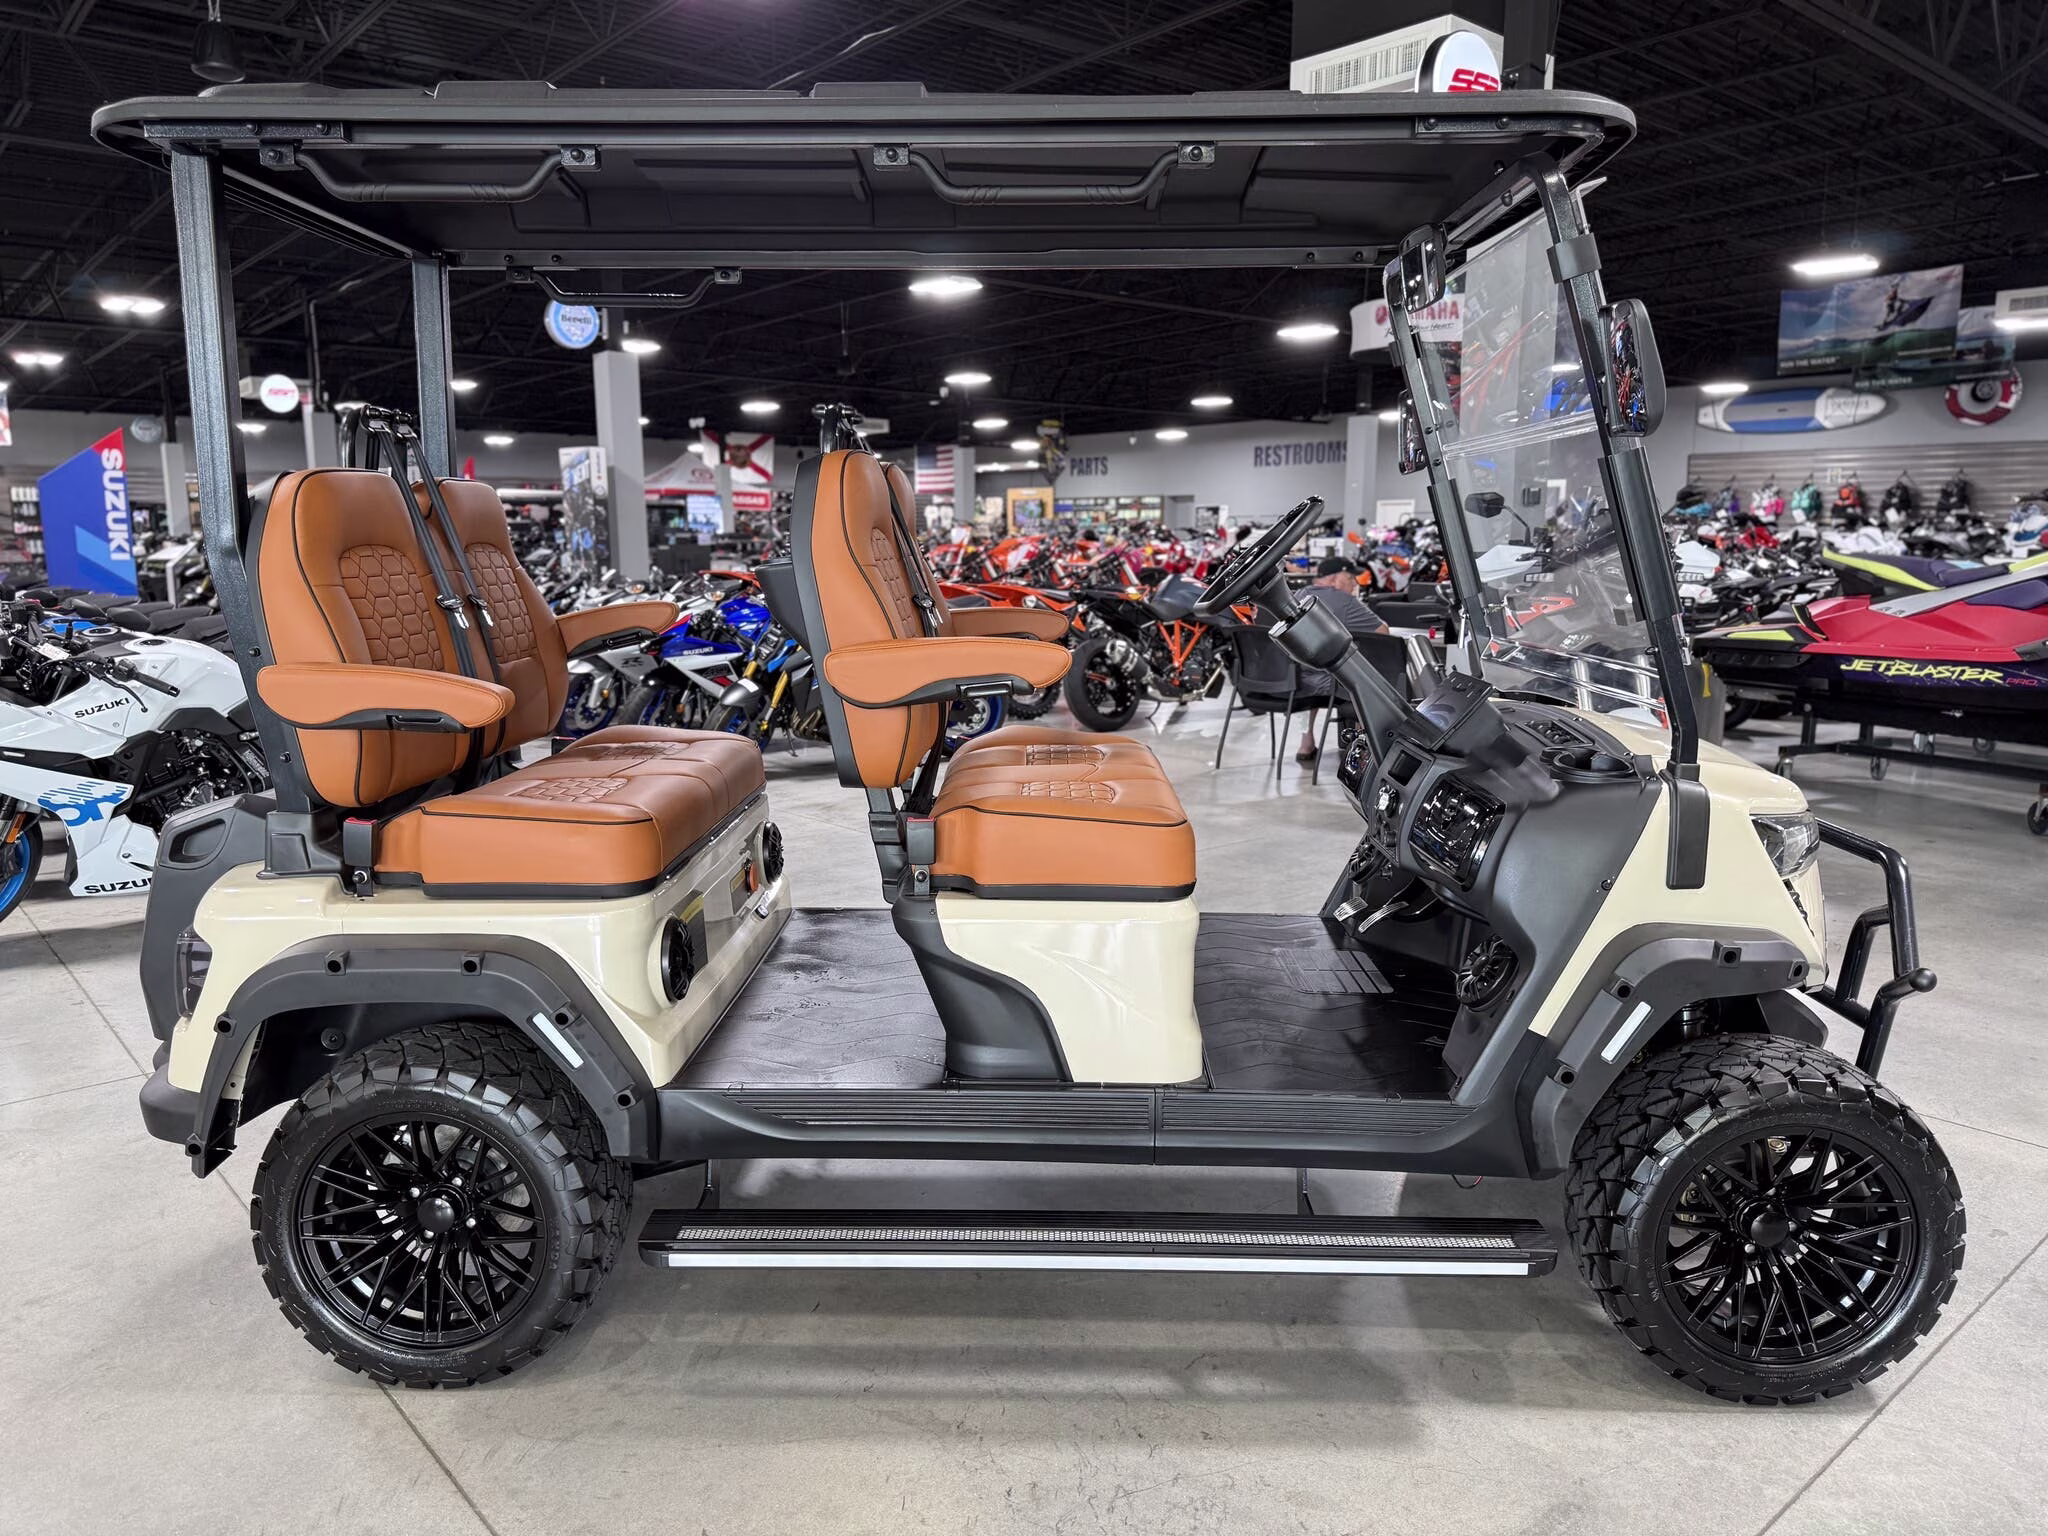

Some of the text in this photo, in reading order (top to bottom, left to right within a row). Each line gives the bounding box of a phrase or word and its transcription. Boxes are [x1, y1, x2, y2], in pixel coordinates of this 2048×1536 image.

[1070, 456, 1108, 476] PARTS
[101, 448, 131, 560] SUZUKI
[683, 646, 714, 656] SUZUKI
[1840, 658, 2004, 684] JETBLASTER
[74, 697, 130, 718] SUZUKI
